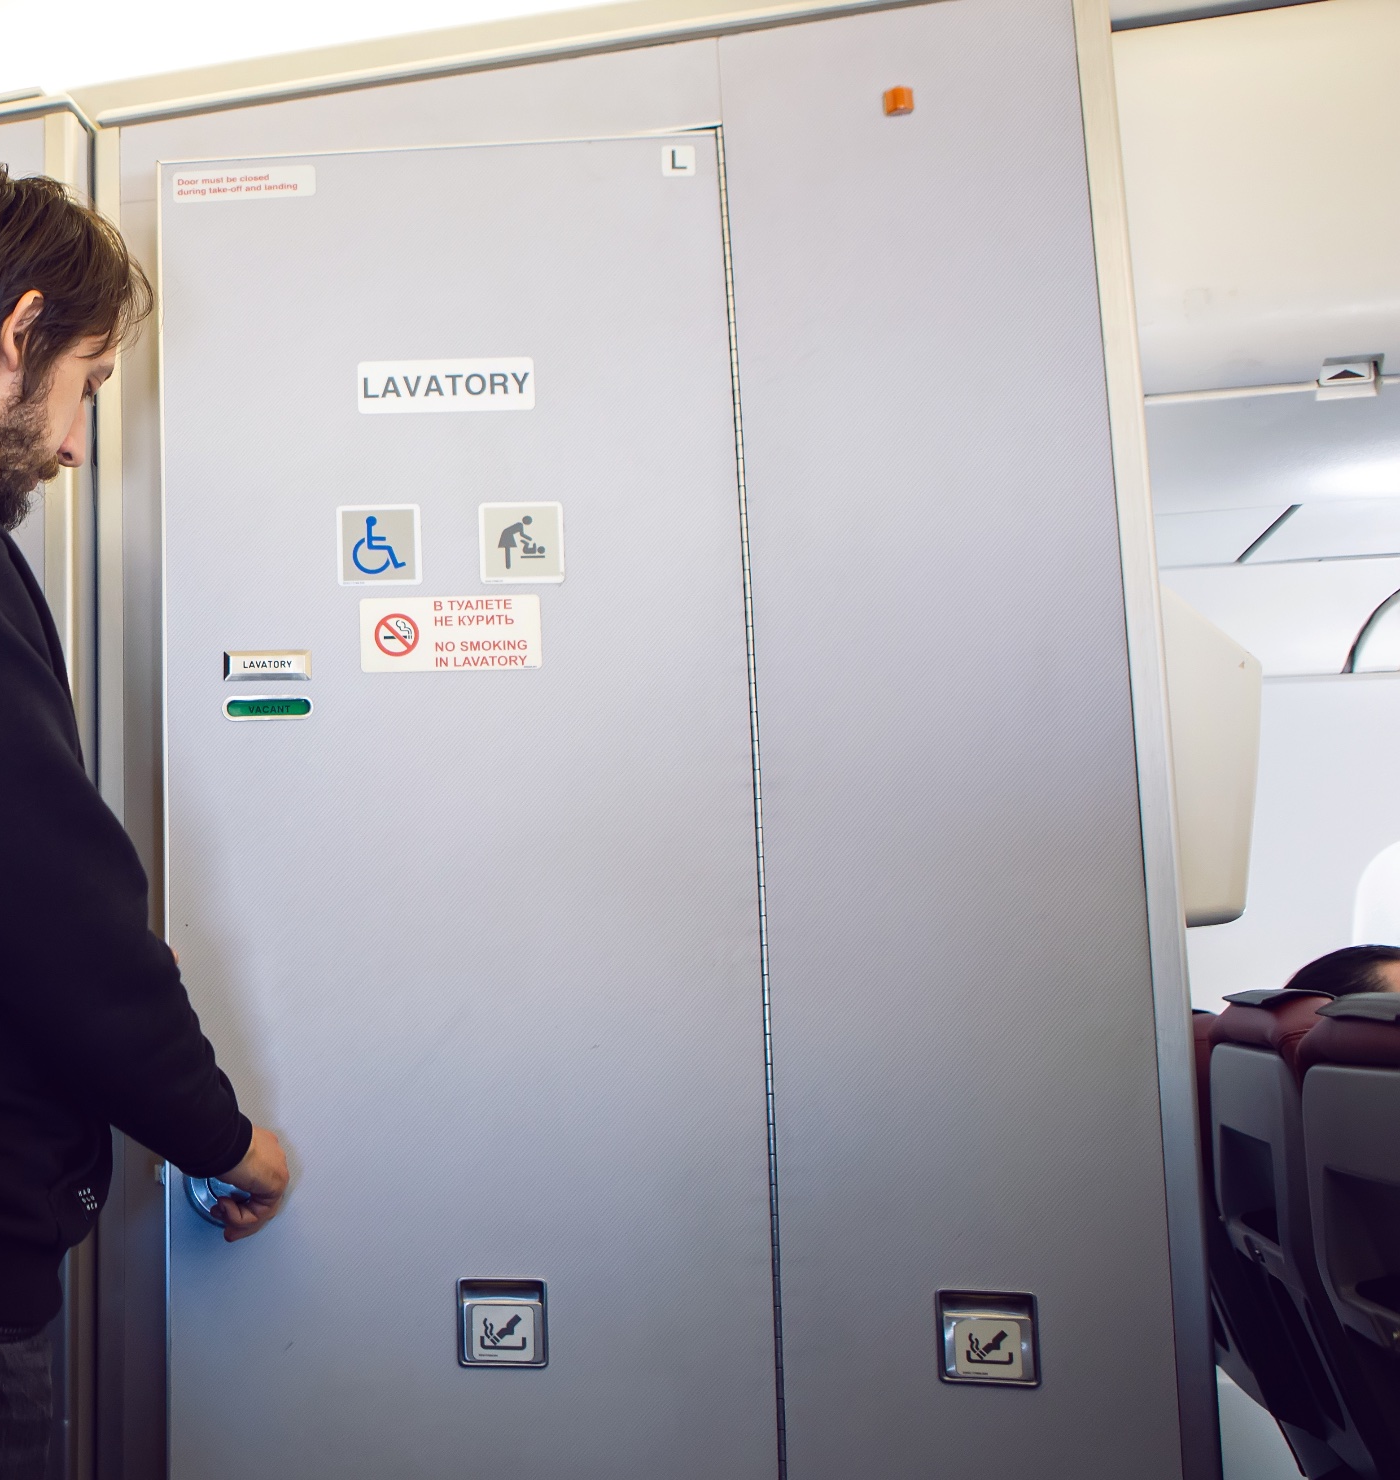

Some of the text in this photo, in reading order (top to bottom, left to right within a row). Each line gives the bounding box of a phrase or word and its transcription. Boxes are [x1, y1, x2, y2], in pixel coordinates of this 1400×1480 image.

[671, 149, 688, 170] L
[177, 178, 199, 186] Door
[226, 175, 237, 183] be
[239, 174, 270, 182] closed
[177, 183, 298, 196] during take-off and landing
[363, 371, 530, 399] LAVATORY
[433, 598, 513, 611] В ТУАЛЕТЕ
[434, 614, 515, 626] НЕ КУРИТЬ
[434, 639, 528, 652] NO SMOKING
[243, 660, 292, 669] LAVATORY
[435, 655, 528, 668] IN LAVATORY
[248, 705, 291, 714] VACANT
